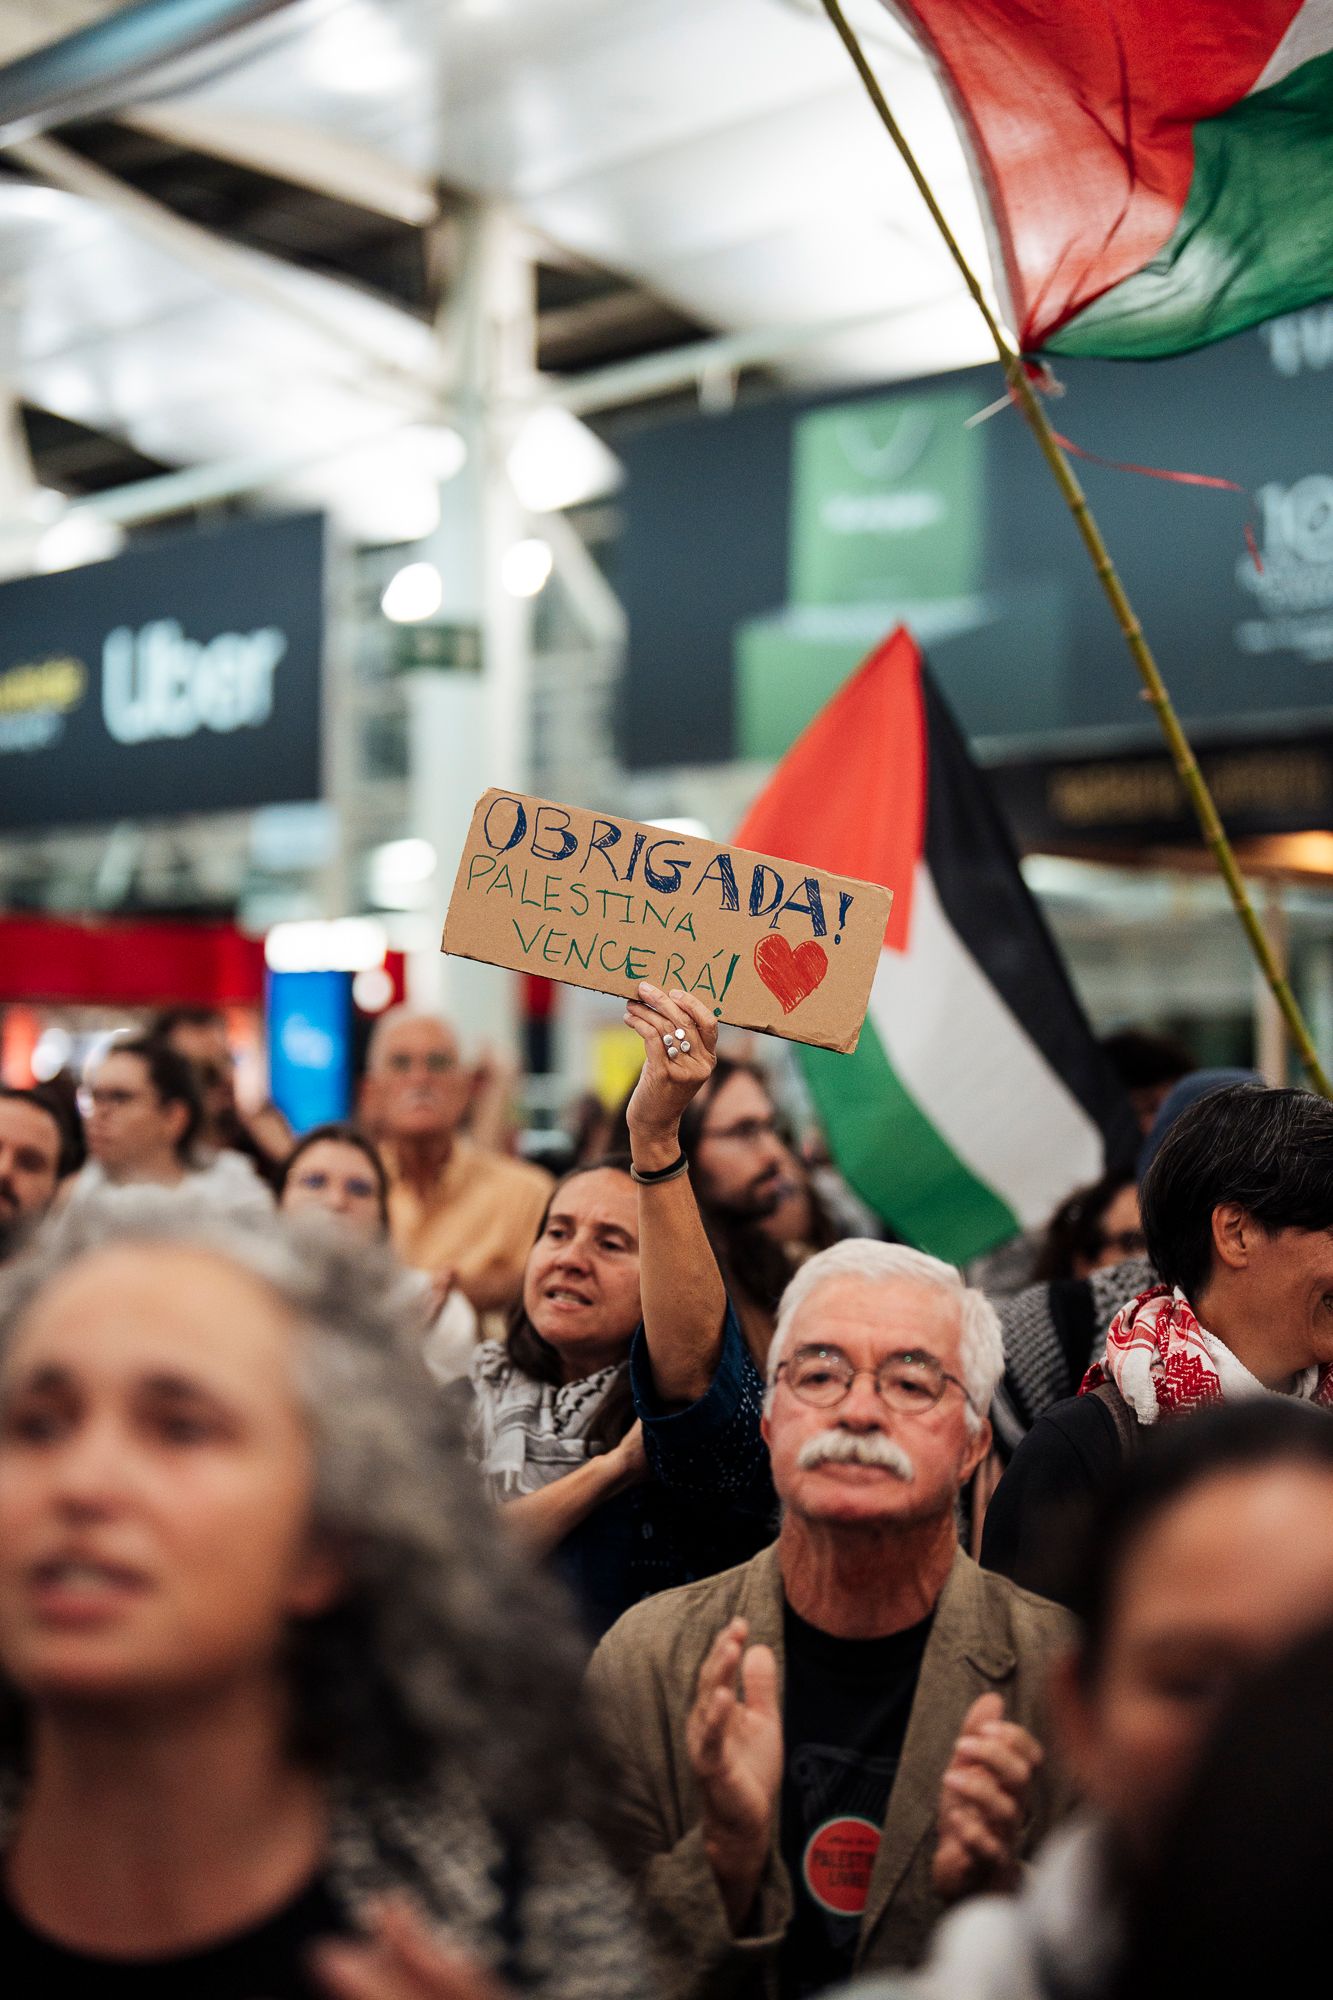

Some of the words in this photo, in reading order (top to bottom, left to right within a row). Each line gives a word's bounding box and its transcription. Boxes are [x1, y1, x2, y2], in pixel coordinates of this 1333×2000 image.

[102, 617, 287, 744] Uber
[467, 854, 697, 941] PALESTINA
[484, 797, 854, 945] OBRIGADA!
[512, 918, 741, 1017] VENCERÁ!
